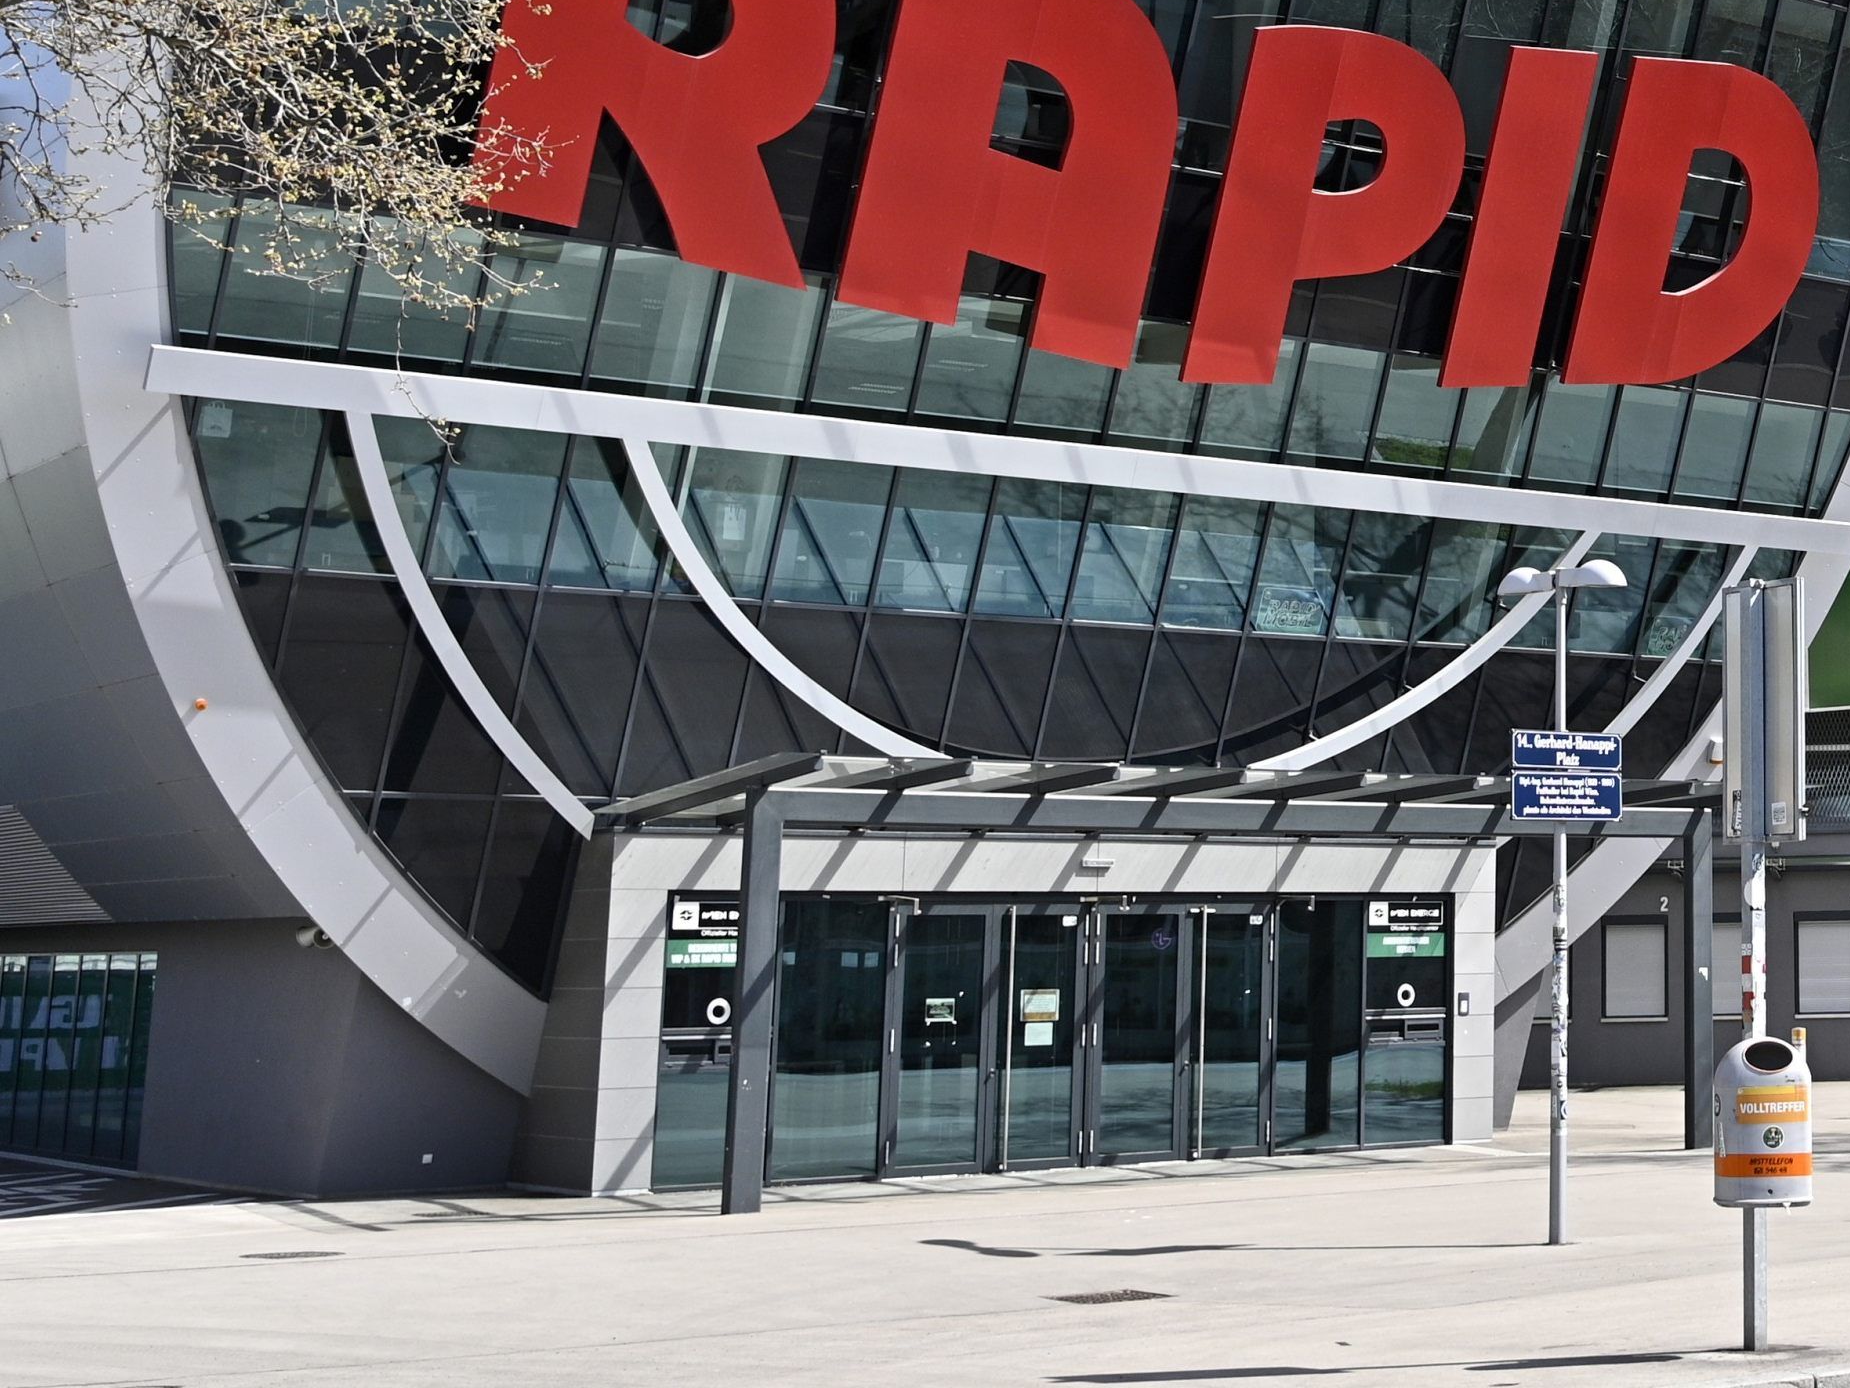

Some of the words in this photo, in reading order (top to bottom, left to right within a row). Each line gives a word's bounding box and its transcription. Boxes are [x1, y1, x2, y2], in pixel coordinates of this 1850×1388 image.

[1534, 734, 1617, 755] Gerhard-Hanappi-
[1556, 751, 1580, 766] Platz
[1660, 896, 1669, 912] 2
[1740, 1100, 1806, 1114] VOLLTREFFER
